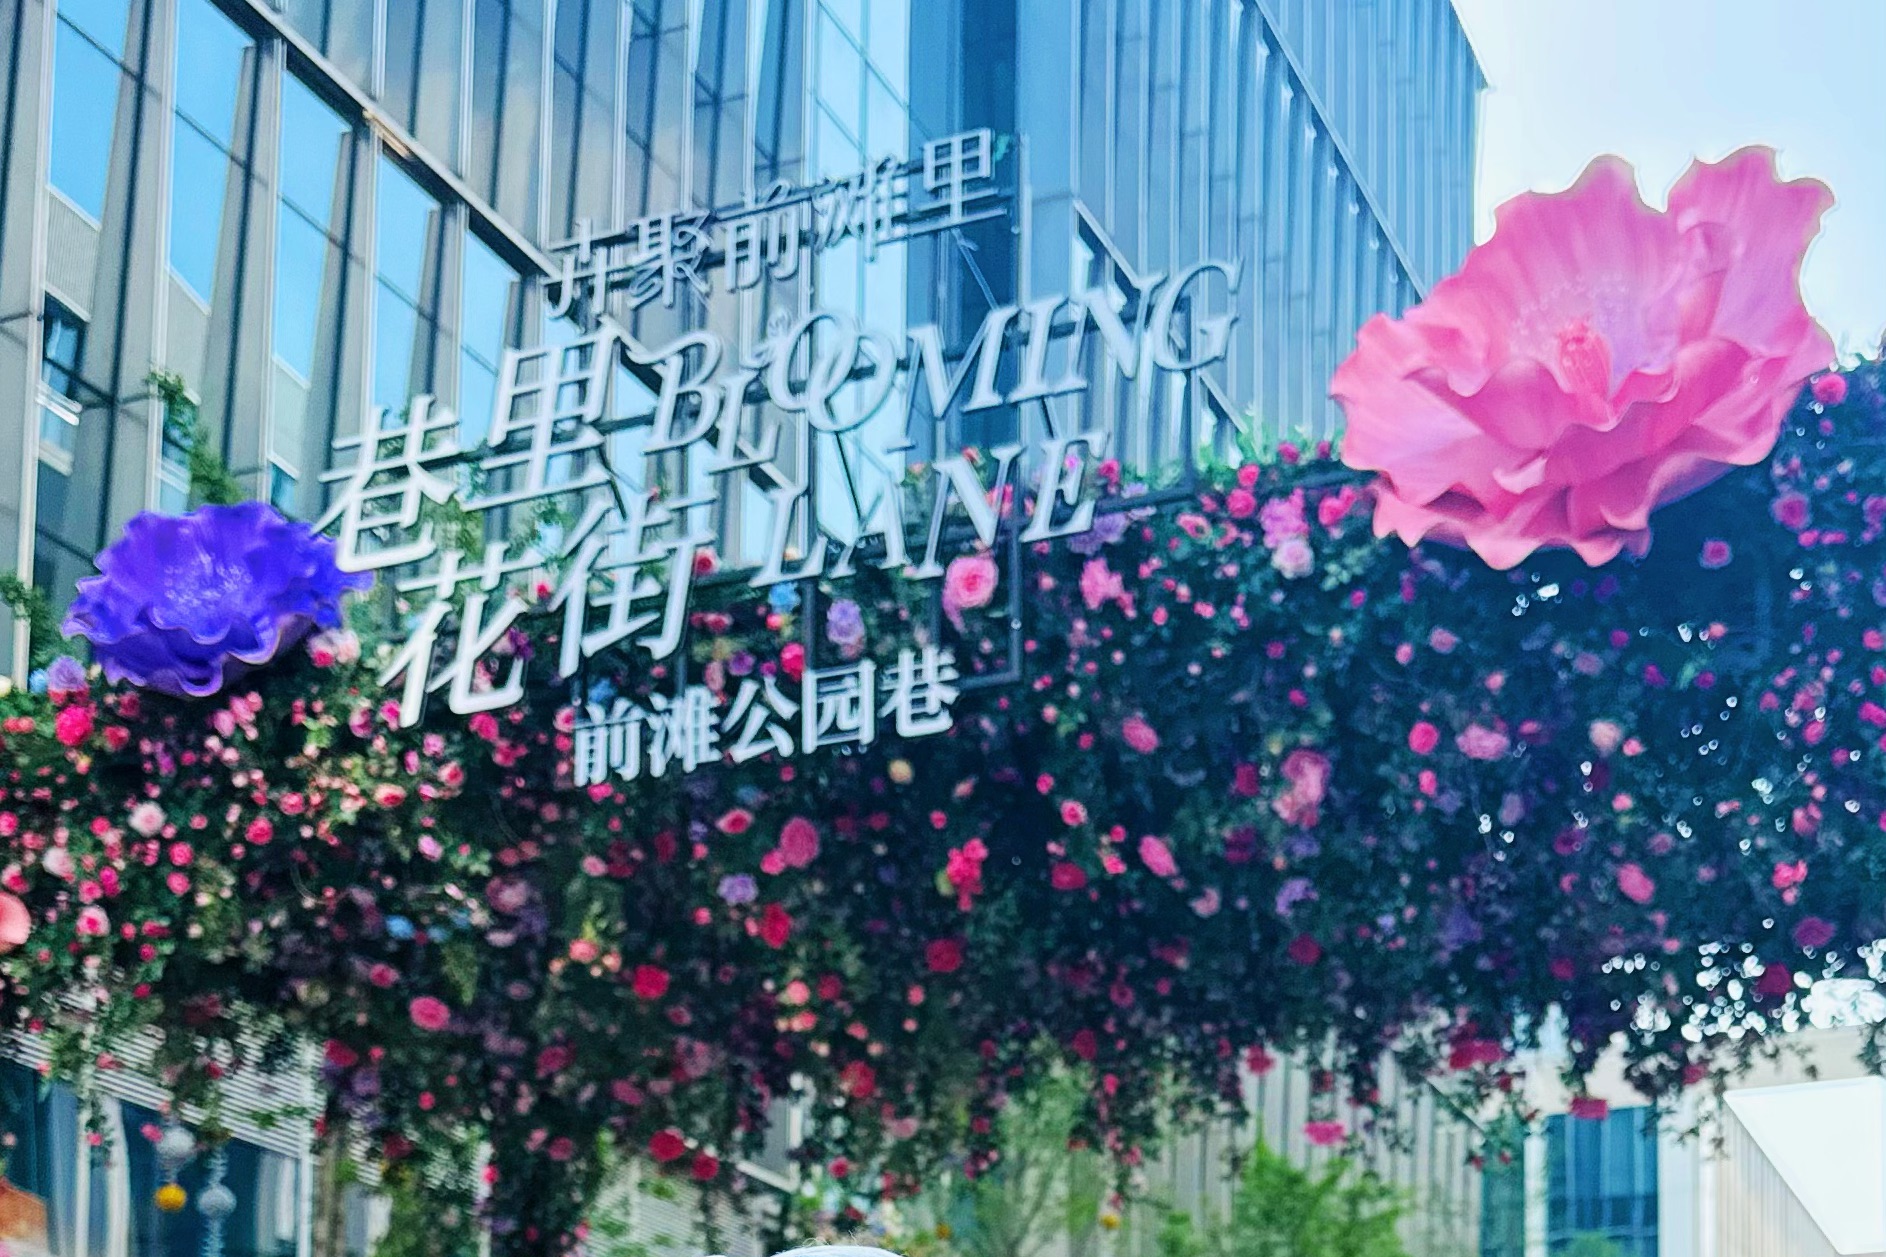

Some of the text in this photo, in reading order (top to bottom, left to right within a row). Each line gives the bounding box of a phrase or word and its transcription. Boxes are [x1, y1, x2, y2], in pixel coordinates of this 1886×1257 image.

[312, 317, 614, 573] 巷里
[620, 254, 1245, 474] BLOOMING
[377, 491, 719, 729] 花街
[748, 430, 1110, 588] LANE
[572, 646, 961, 787] 前滩公园巷
